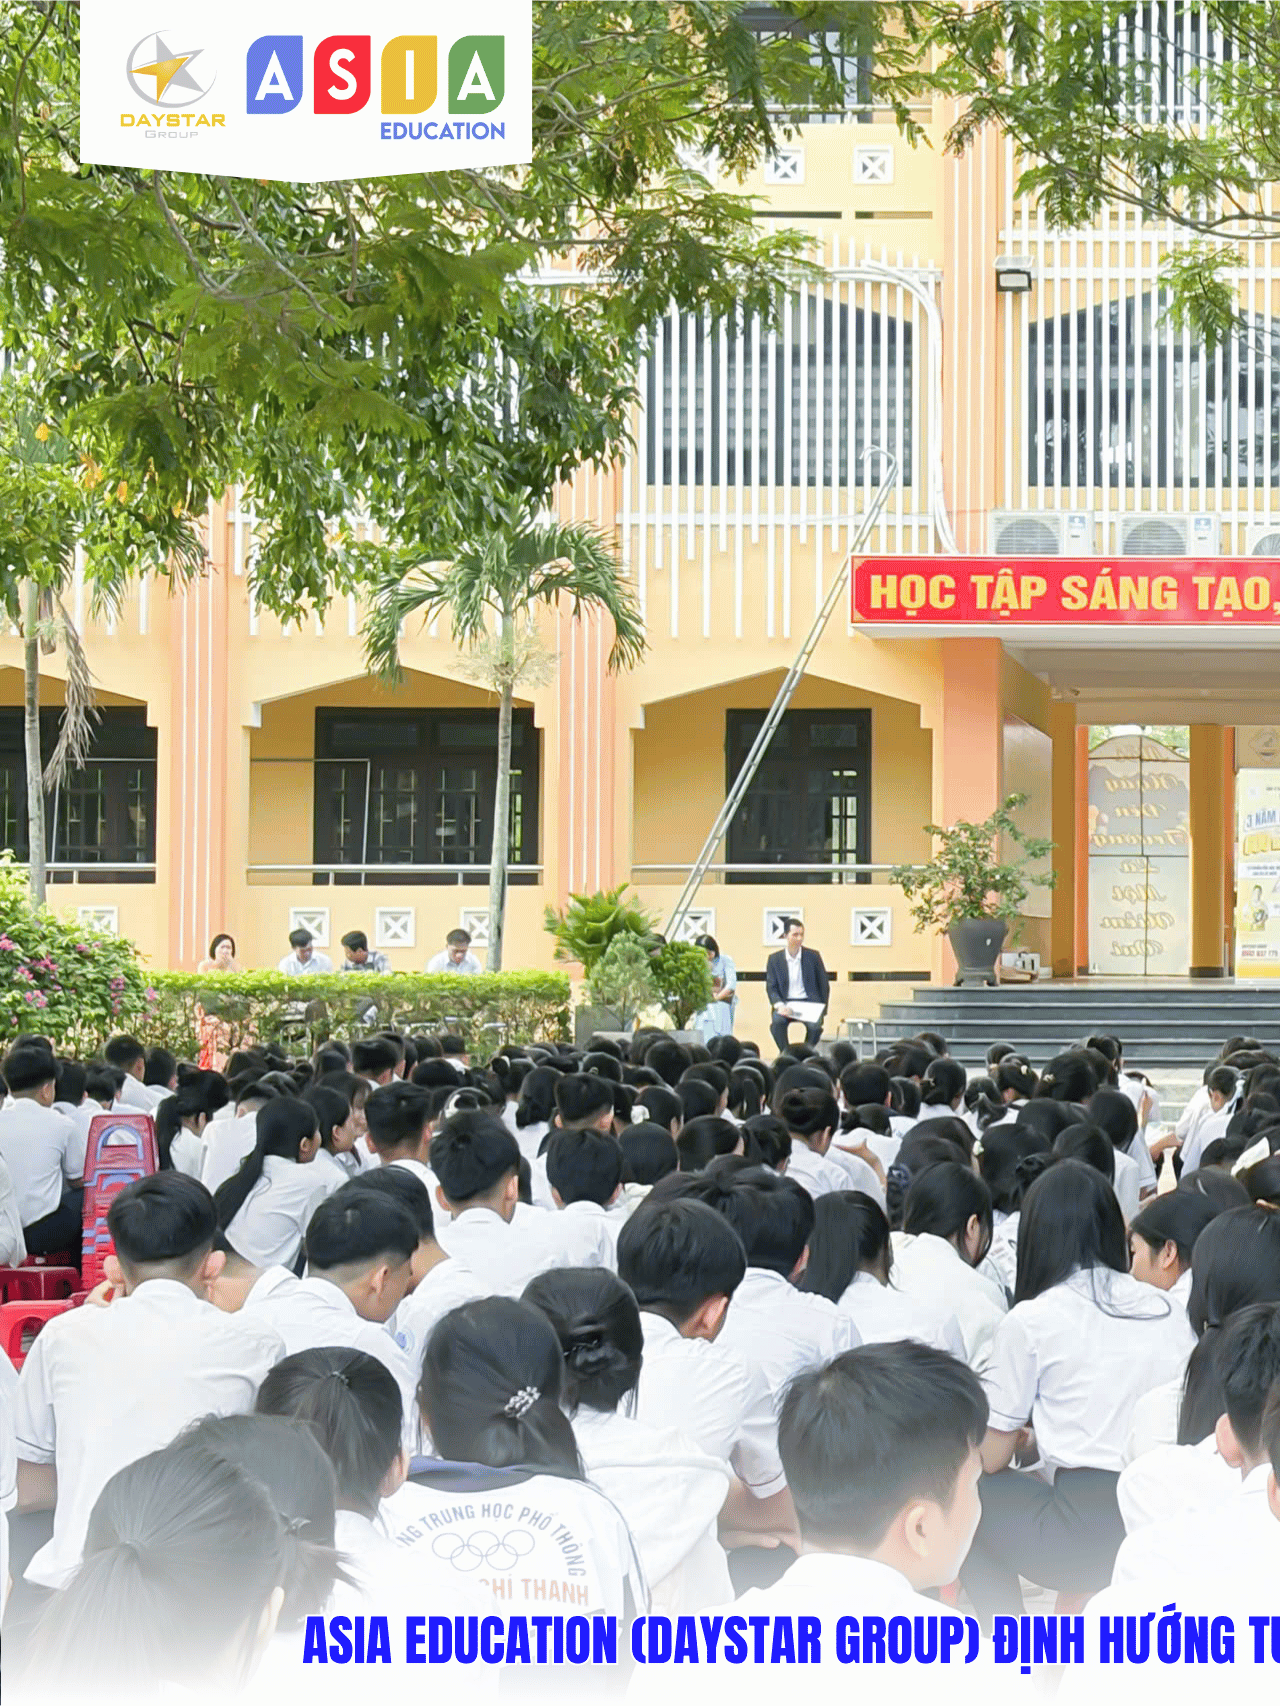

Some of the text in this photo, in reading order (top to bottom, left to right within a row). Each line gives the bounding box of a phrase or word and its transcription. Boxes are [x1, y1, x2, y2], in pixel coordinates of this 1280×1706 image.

[870, 575, 956, 616] HỌC
[971, 568, 1048, 617] TẬP
[1061, 567, 1178, 611] SÁNG
[418, 1502, 587, 1578] TRUNG HỌC PHỔ THÔNG
[520, 1577, 590, 1607] THANH
